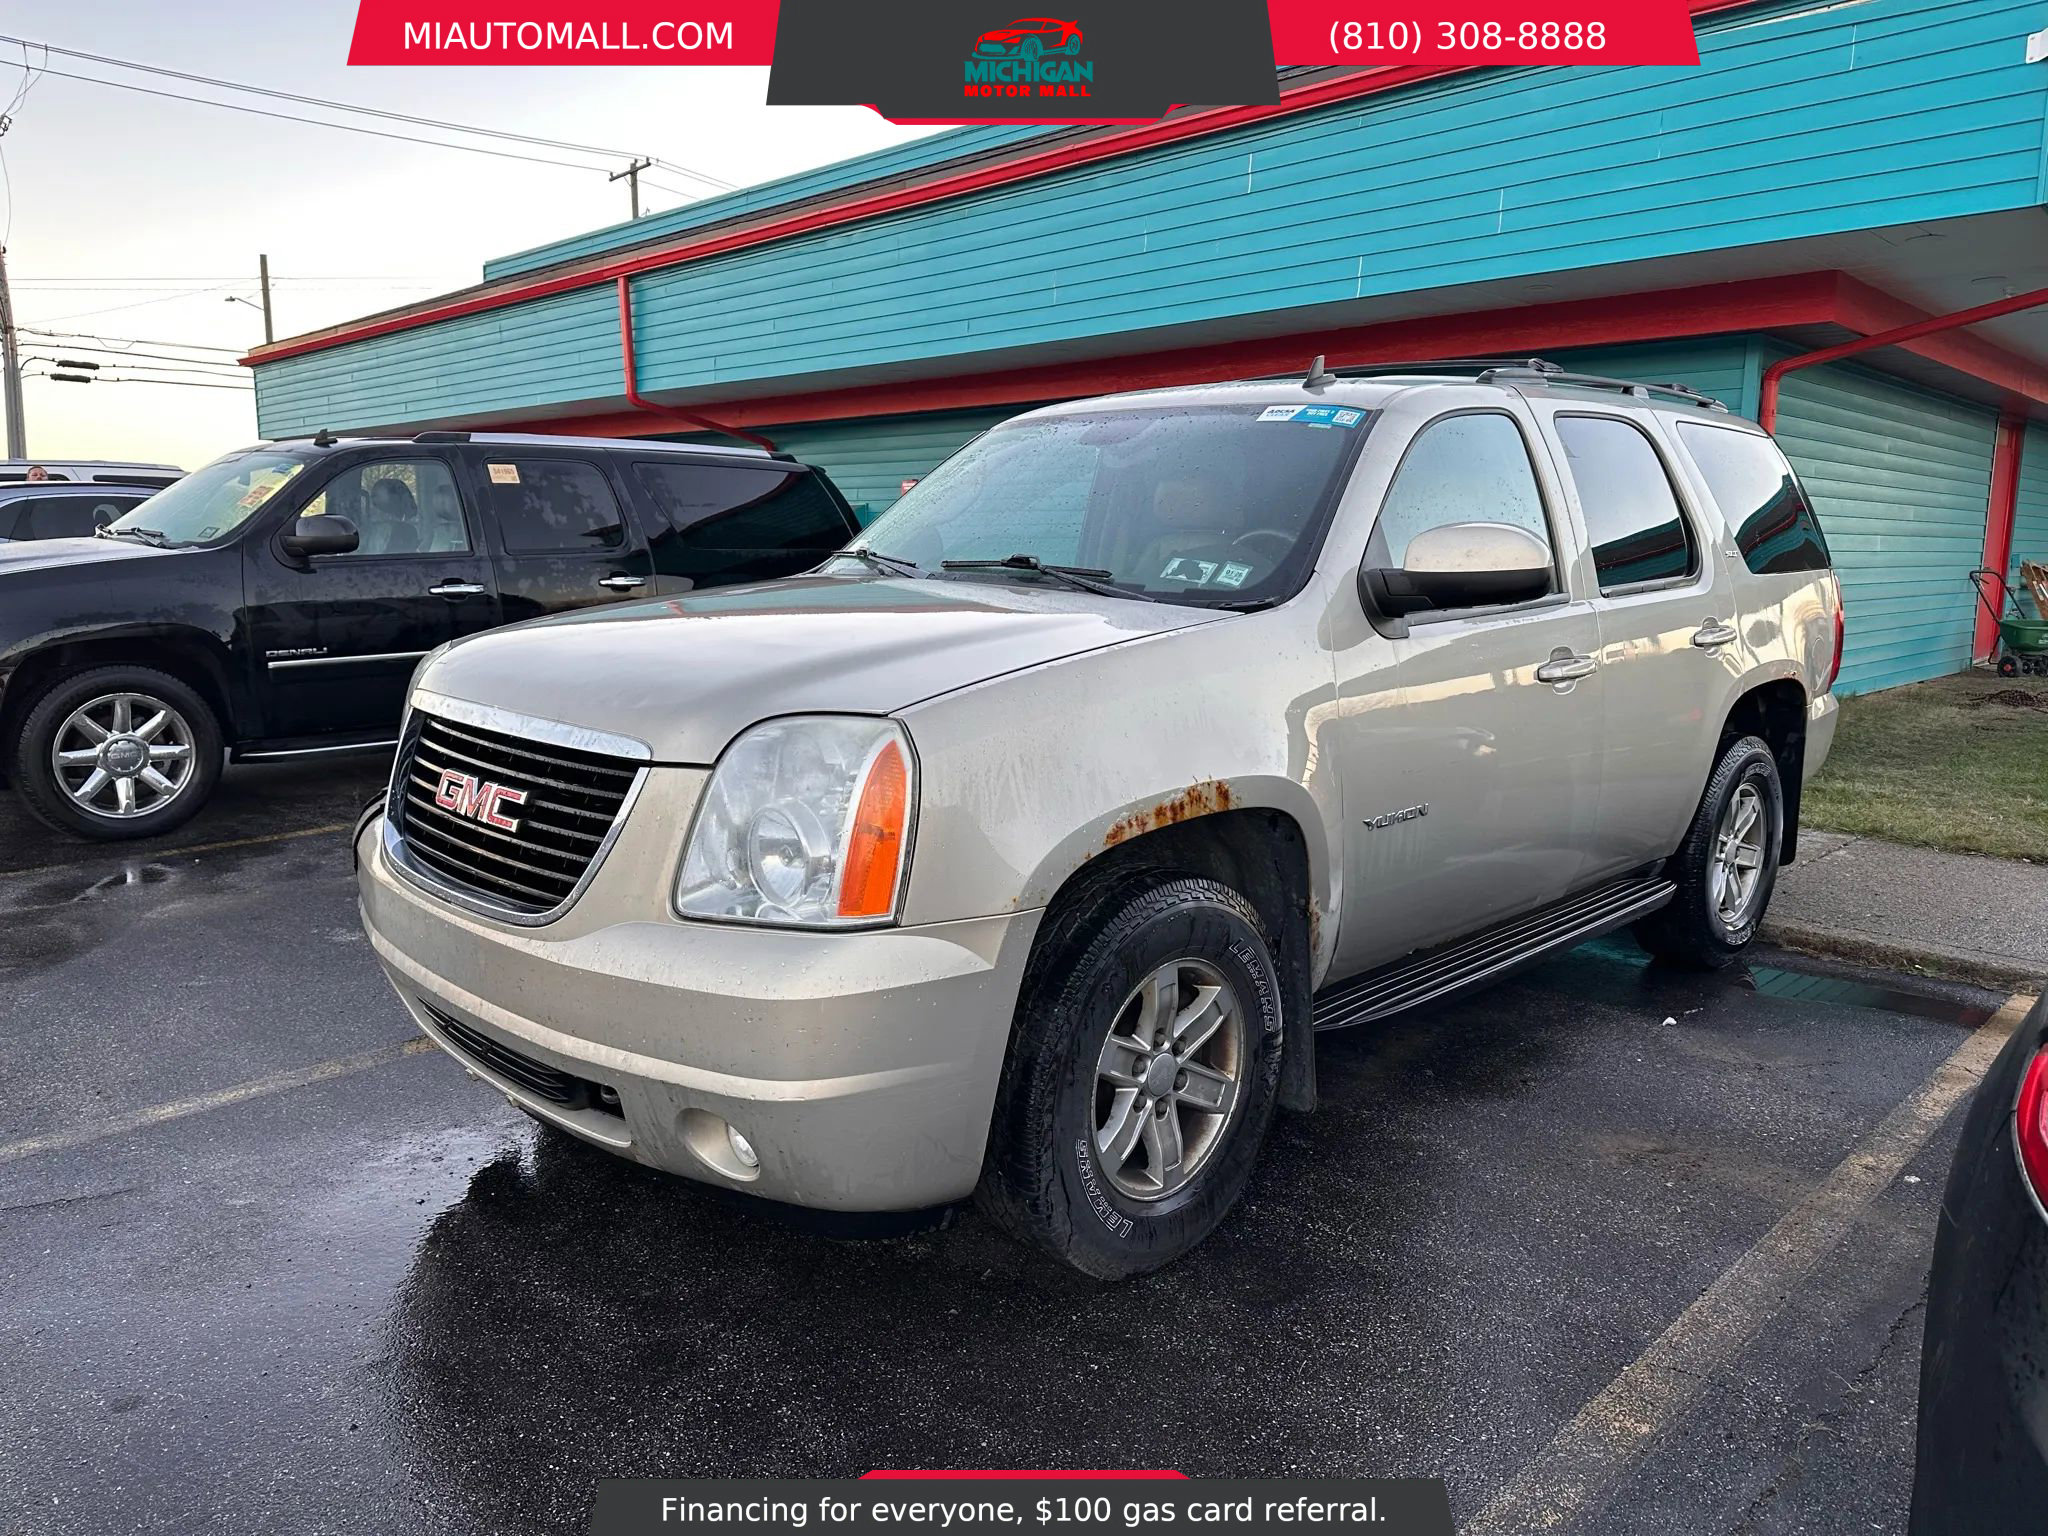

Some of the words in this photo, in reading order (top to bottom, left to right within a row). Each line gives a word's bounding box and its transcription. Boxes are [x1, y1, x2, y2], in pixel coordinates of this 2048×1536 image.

[265, 646, 328, 658] DENALI
[110, 752, 138, 760] GMC
[435, 767, 528, 833] GMC
[1362, 802, 1429, 832] YUKON
